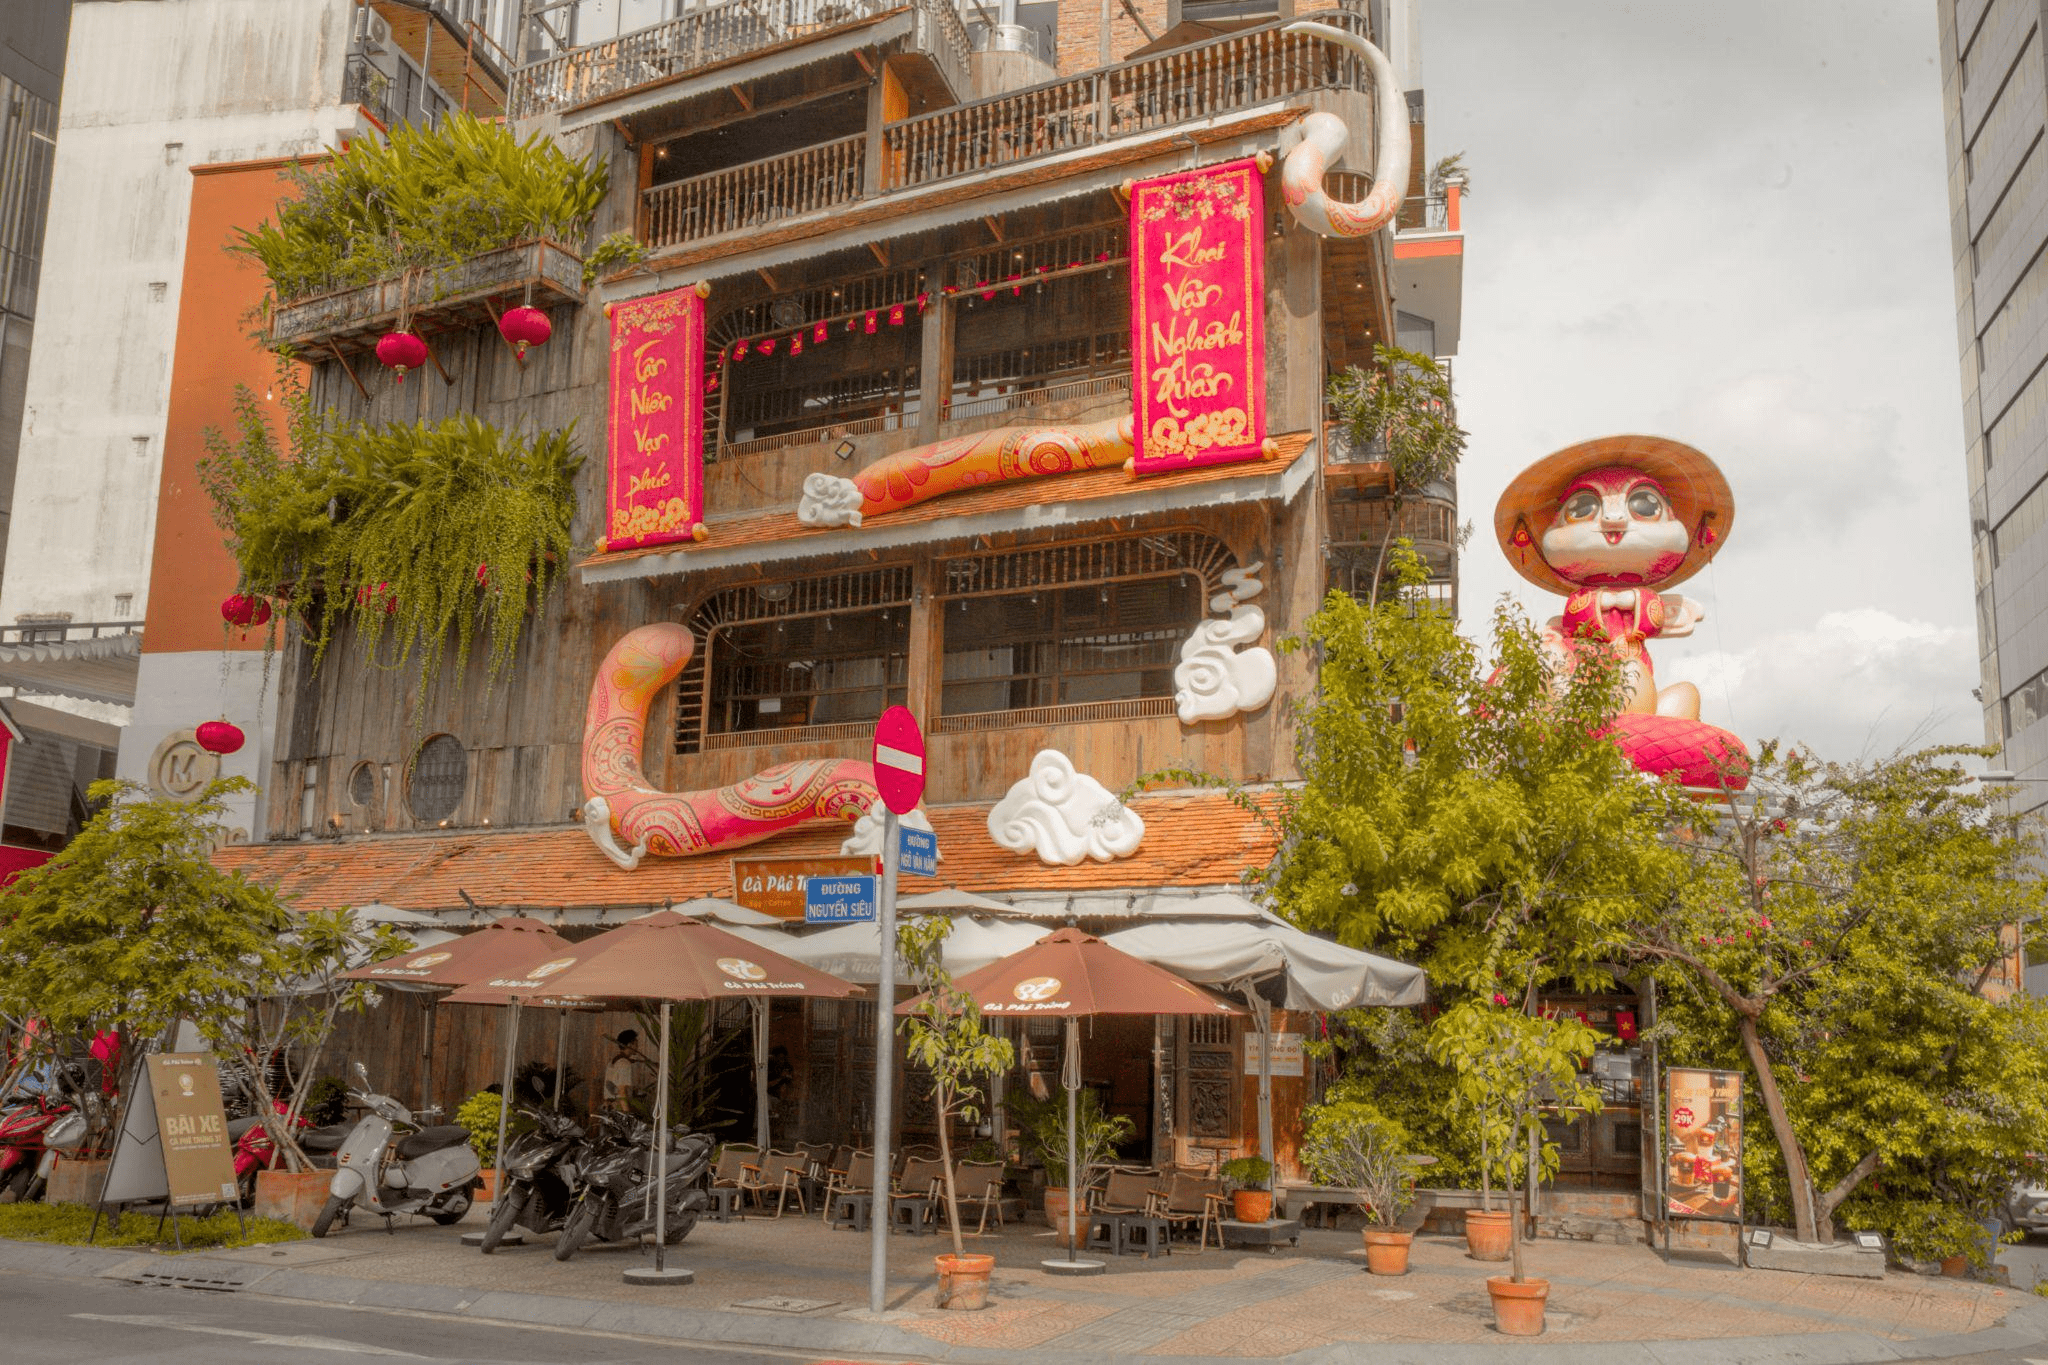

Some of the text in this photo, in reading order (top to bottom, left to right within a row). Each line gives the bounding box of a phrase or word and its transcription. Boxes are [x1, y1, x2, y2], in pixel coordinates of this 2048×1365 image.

[1160, 225, 1227, 275] Khai
[1163, 275, 1224, 317] Vận
[633, 339, 668, 383] Tân
[1152, 310, 1244, 381] Nghênh
[631, 385, 673, 421] Niên
[1152, 359, 1233, 418] Xuân
[634, 419, 670, 457] Vạn
[742, 874, 762, 893] Cà
[766, 874, 794, 892] Phê
[821, 882, 861, 895] ĐƯỜNG
[850, 899, 873, 917] SIÊU
[166, 1114, 221, 1135] BÃI XE
